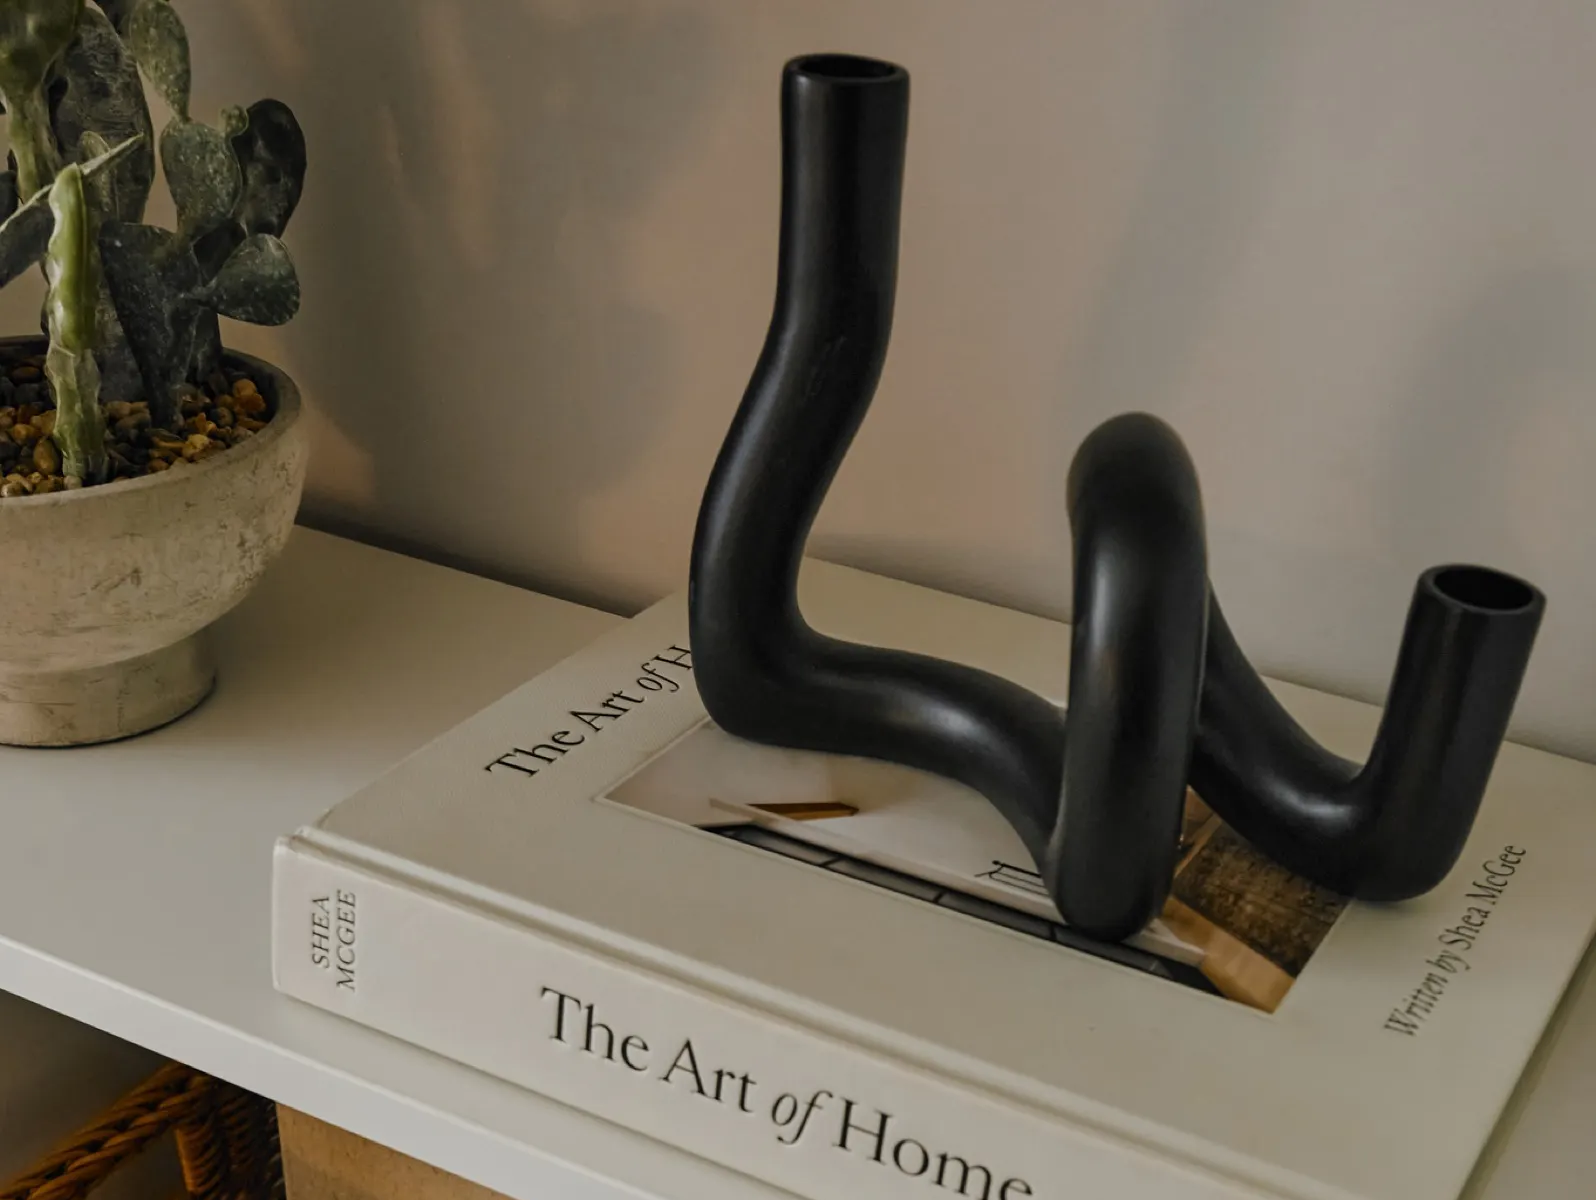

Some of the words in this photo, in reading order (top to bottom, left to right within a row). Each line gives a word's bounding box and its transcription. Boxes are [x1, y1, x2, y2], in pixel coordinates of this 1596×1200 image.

[484, 730, 585, 777] The
[569, 690, 645, 732] Art
[636, 662, 680, 692] of
[1465, 845, 1527, 906] McGee
[312, 897, 330, 969] SHEA
[336, 889, 356, 992] MCGEE
[1425, 949, 1472, 974] by
[1438, 906, 1491, 950] Shea
[1383, 972, 1449, 1037] Written
[541, 986, 650, 1071] The
[657, 1037, 757, 1113] Art
[771, 1089, 834, 1145] of
